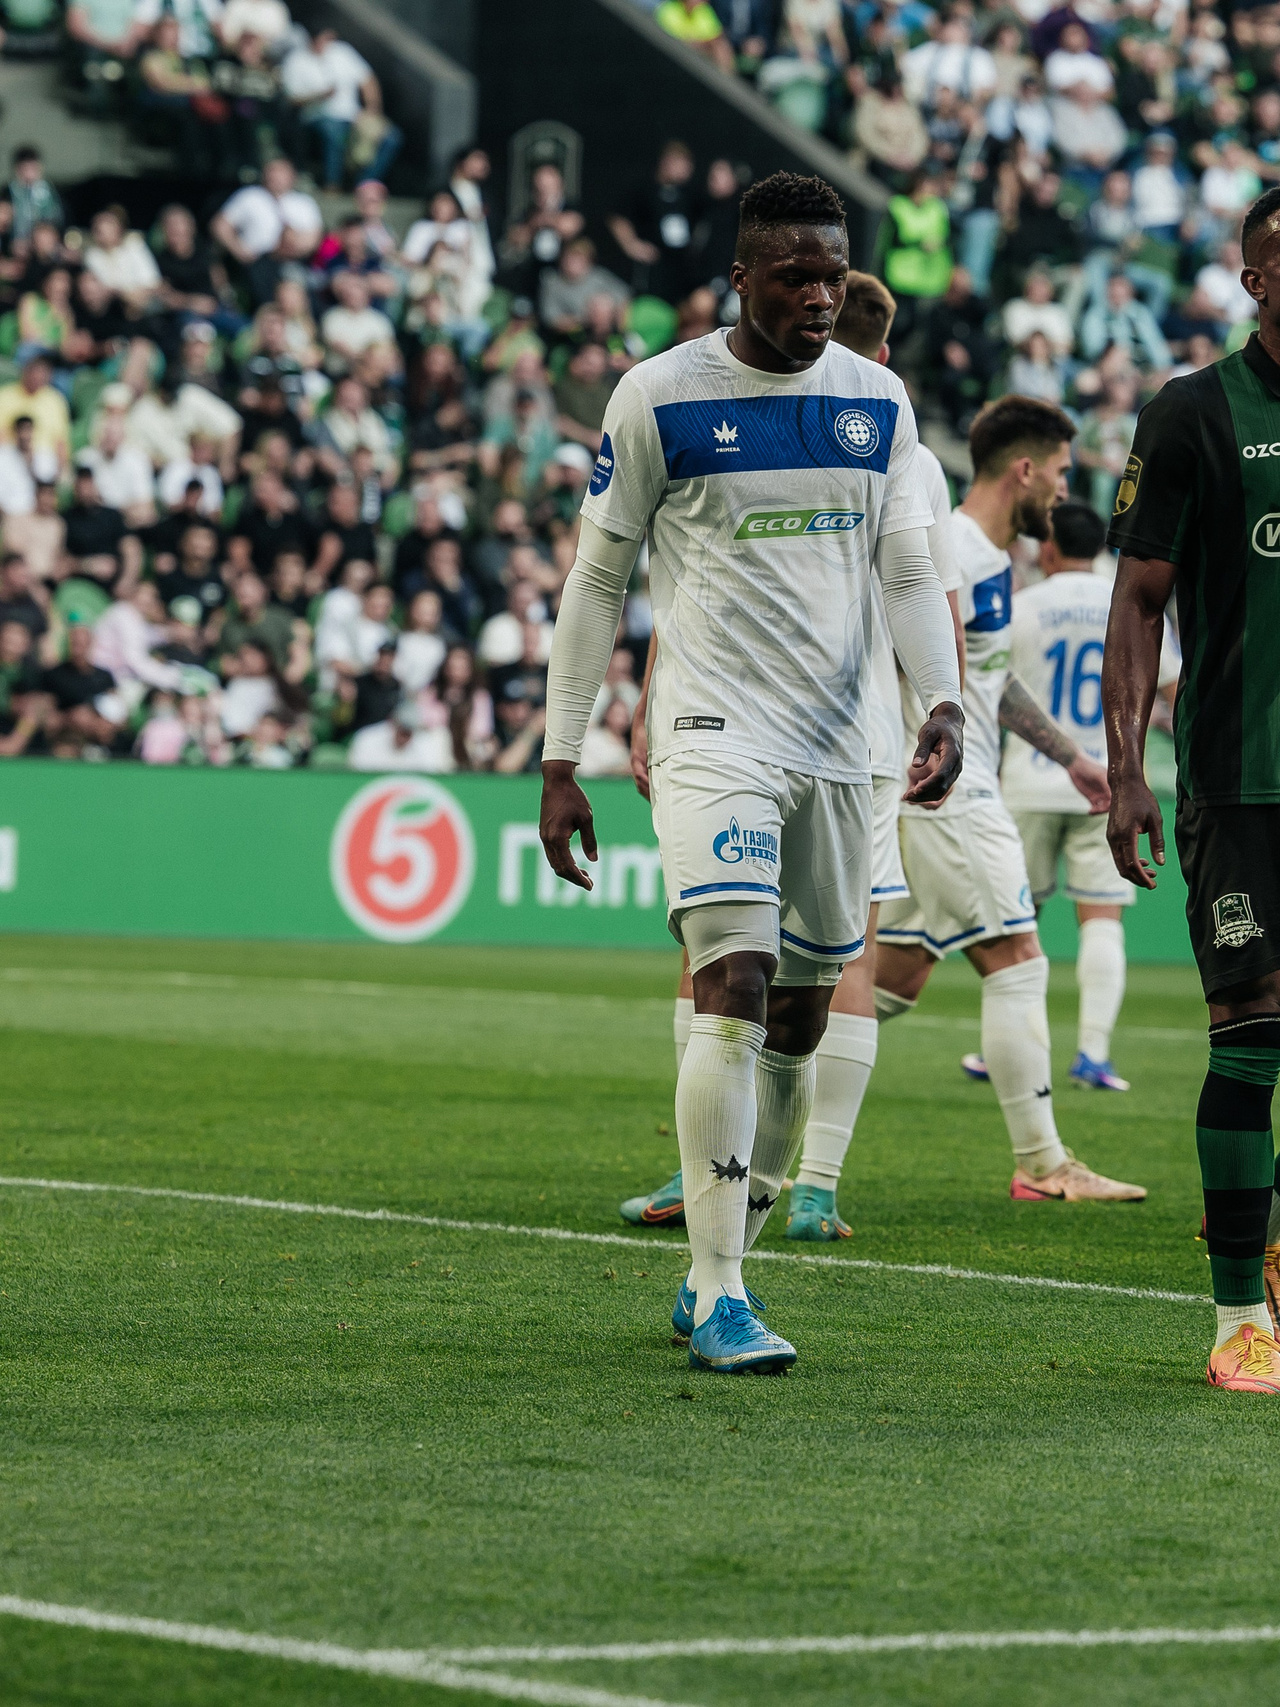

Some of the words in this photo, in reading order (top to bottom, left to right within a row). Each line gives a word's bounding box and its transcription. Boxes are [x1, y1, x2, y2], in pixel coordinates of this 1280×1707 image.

[837, 412, 875, 430] ОРЕНБУРГ
[747, 517, 802, 532] ECO
[1044, 638, 1105, 728] 16
[367, 798, 447, 910] 5
[745, 847, 777, 864] ДОБЫЧ
